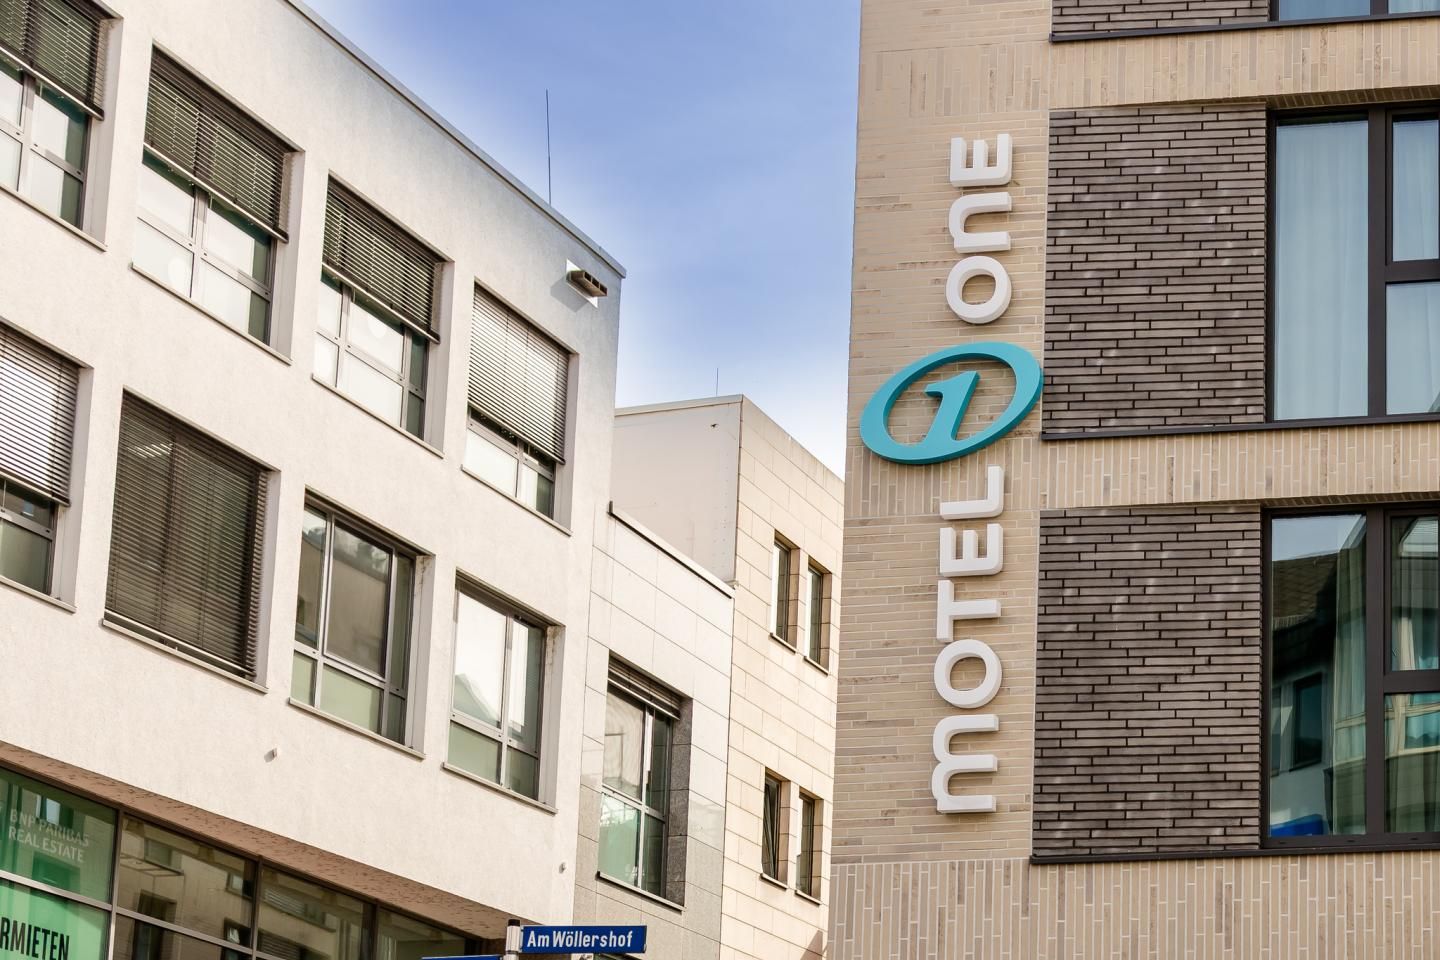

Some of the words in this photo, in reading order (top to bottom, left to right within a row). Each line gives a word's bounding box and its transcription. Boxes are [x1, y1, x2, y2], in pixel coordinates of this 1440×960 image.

[10, 808, 36, 828] BNP
[8, 825, 40, 848] REAL
[42, 838, 85, 863] ESTATE
[527, 930, 550, 948] Am
[552, 930, 633, 948] Wöllershof
